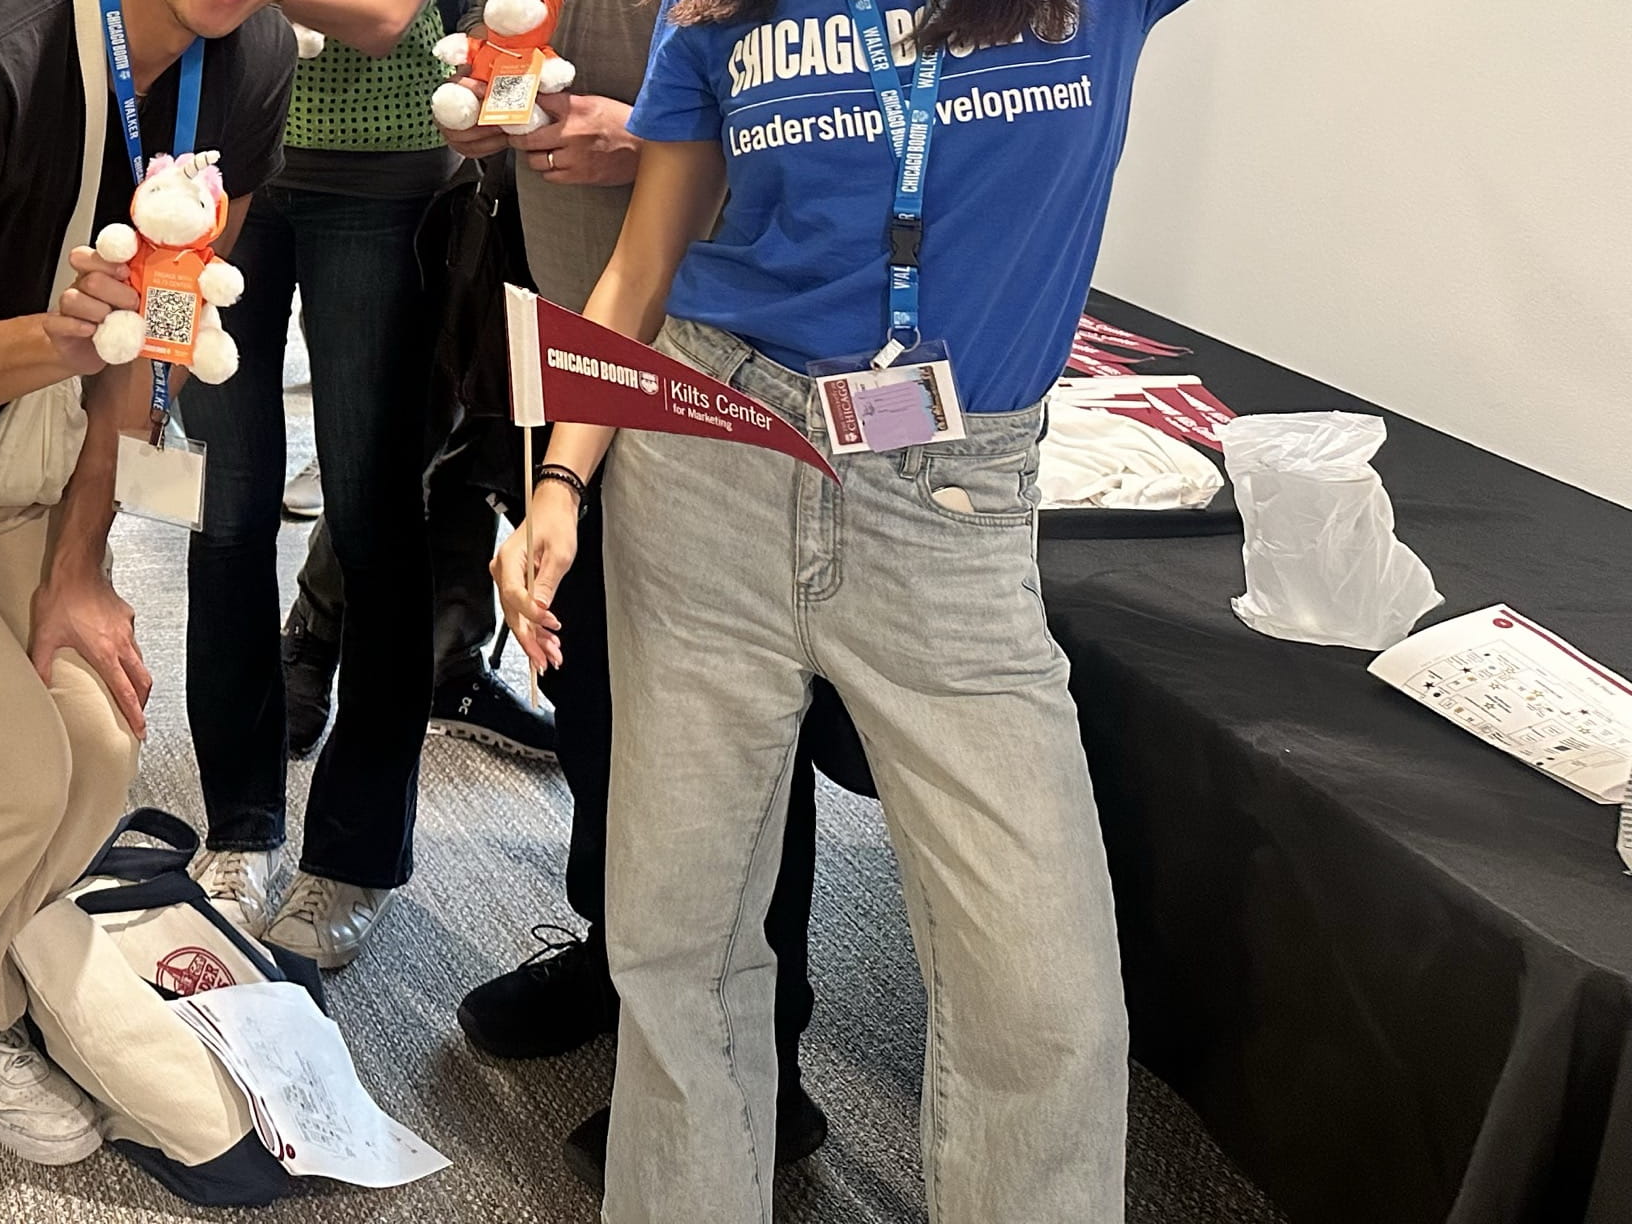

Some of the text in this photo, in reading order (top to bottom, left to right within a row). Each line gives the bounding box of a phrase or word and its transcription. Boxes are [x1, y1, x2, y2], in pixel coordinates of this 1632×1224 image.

[106, 10, 130, 70] CHICAGO BOOTH
[862, 26, 890, 72] WALKER
[124, 97, 139, 140] WALKER
[729, 74, 1093, 158] Leadership velopment
[880, 89, 906, 125] CHICAGO
[908, 123, 929, 153] BOOTH
[901, 152, 924, 193] CHICAGO
[547, 347, 639, 389] CHICAGO BOOTH
[670, 380, 773, 431] Kilts Center
[672, 402, 734, 432] for Marketing
[835, 380, 856, 432] CHICAGO
